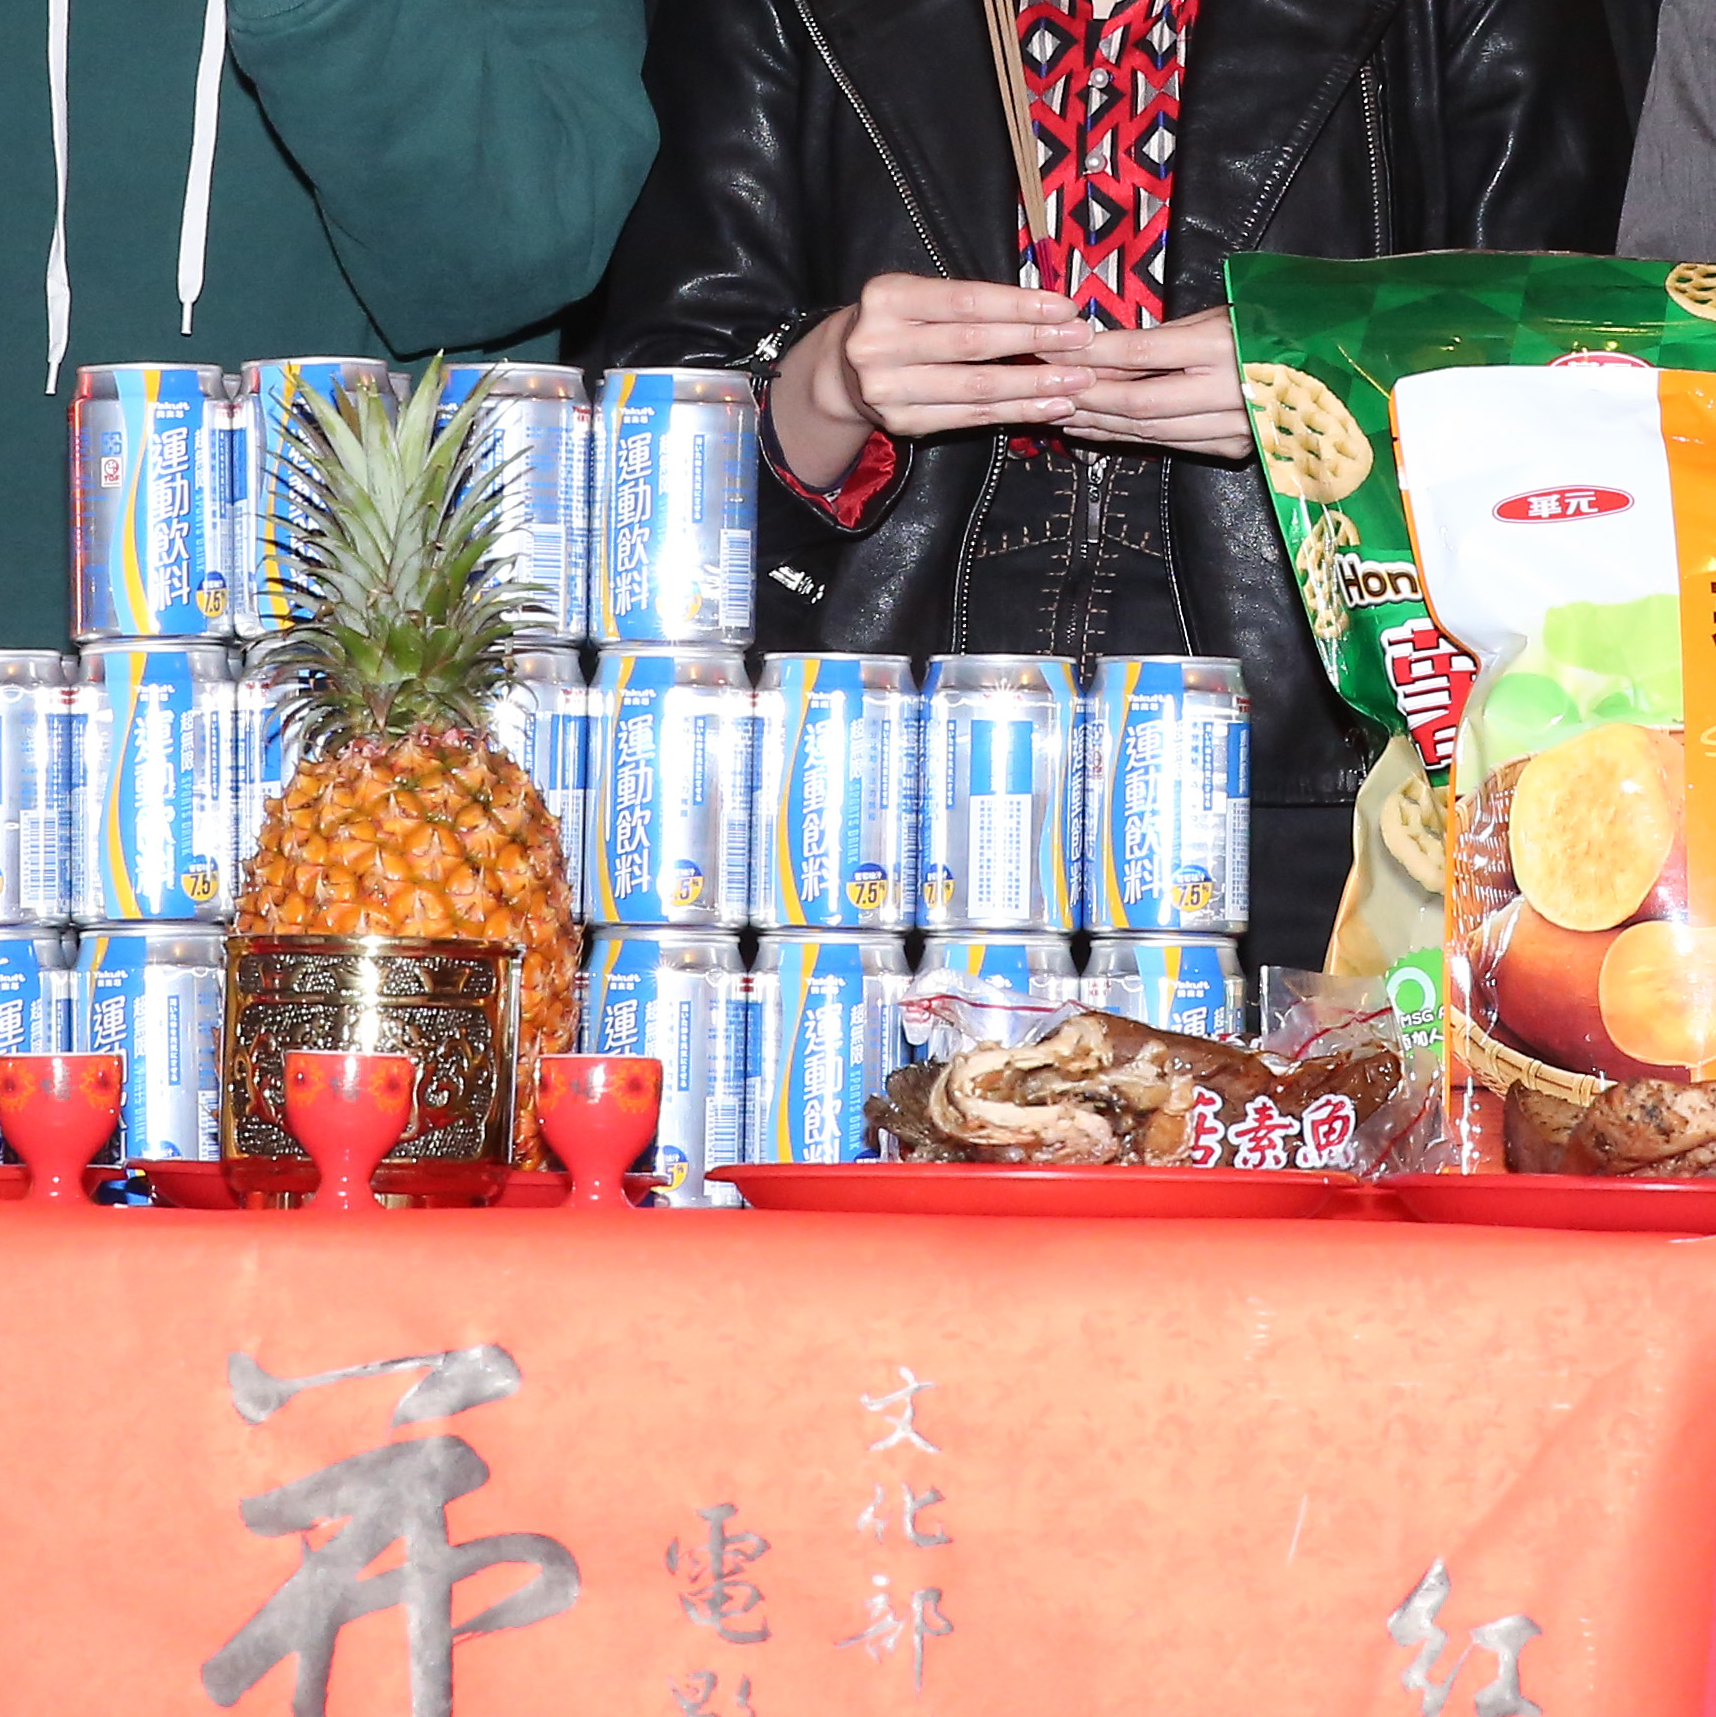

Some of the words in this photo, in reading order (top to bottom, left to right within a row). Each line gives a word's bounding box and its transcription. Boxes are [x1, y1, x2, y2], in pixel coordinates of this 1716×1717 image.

[618, 407, 656, 416] Yakult
[149, 426, 191, 612] 運動飲料
[615, 431, 653, 617] 運動飲料
[1527, 490, 1599, 518] 華元
[614, 713, 655, 900] 運動飲料
[1123, 721, 1164, 904] 運動飲料
[605, 973, 641, 983] Yakult
[1400, 1009, 1434, 1029] MSG
[834, 1364, 956, 1692] 文化部
